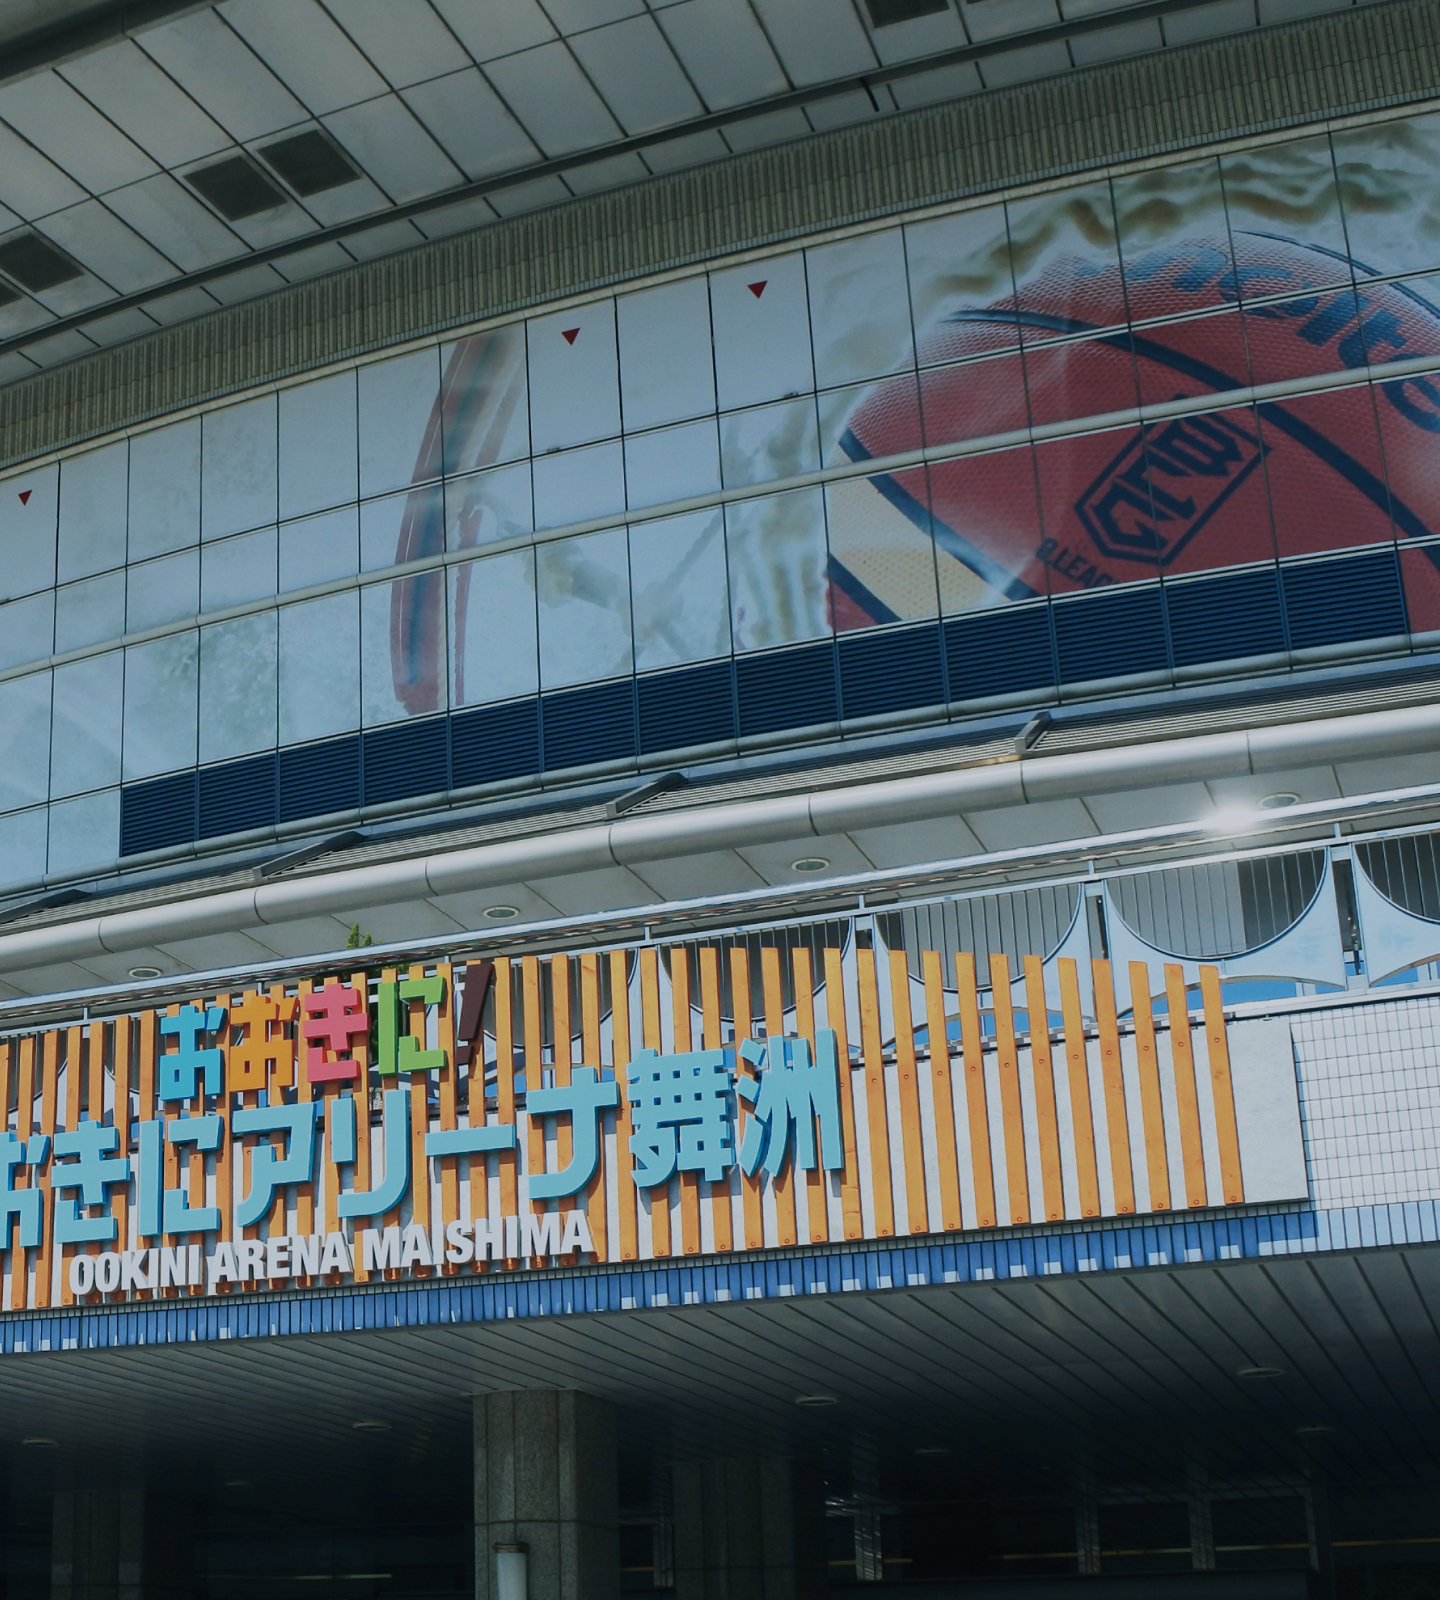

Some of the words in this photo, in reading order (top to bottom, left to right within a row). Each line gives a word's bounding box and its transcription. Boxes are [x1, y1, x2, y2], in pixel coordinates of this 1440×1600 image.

[69, 1243, 202, 1295] OOKINI
[211, 1230, 353, 1284] ARENA
[362, 1209, 595, 1271] MAISHIMA
